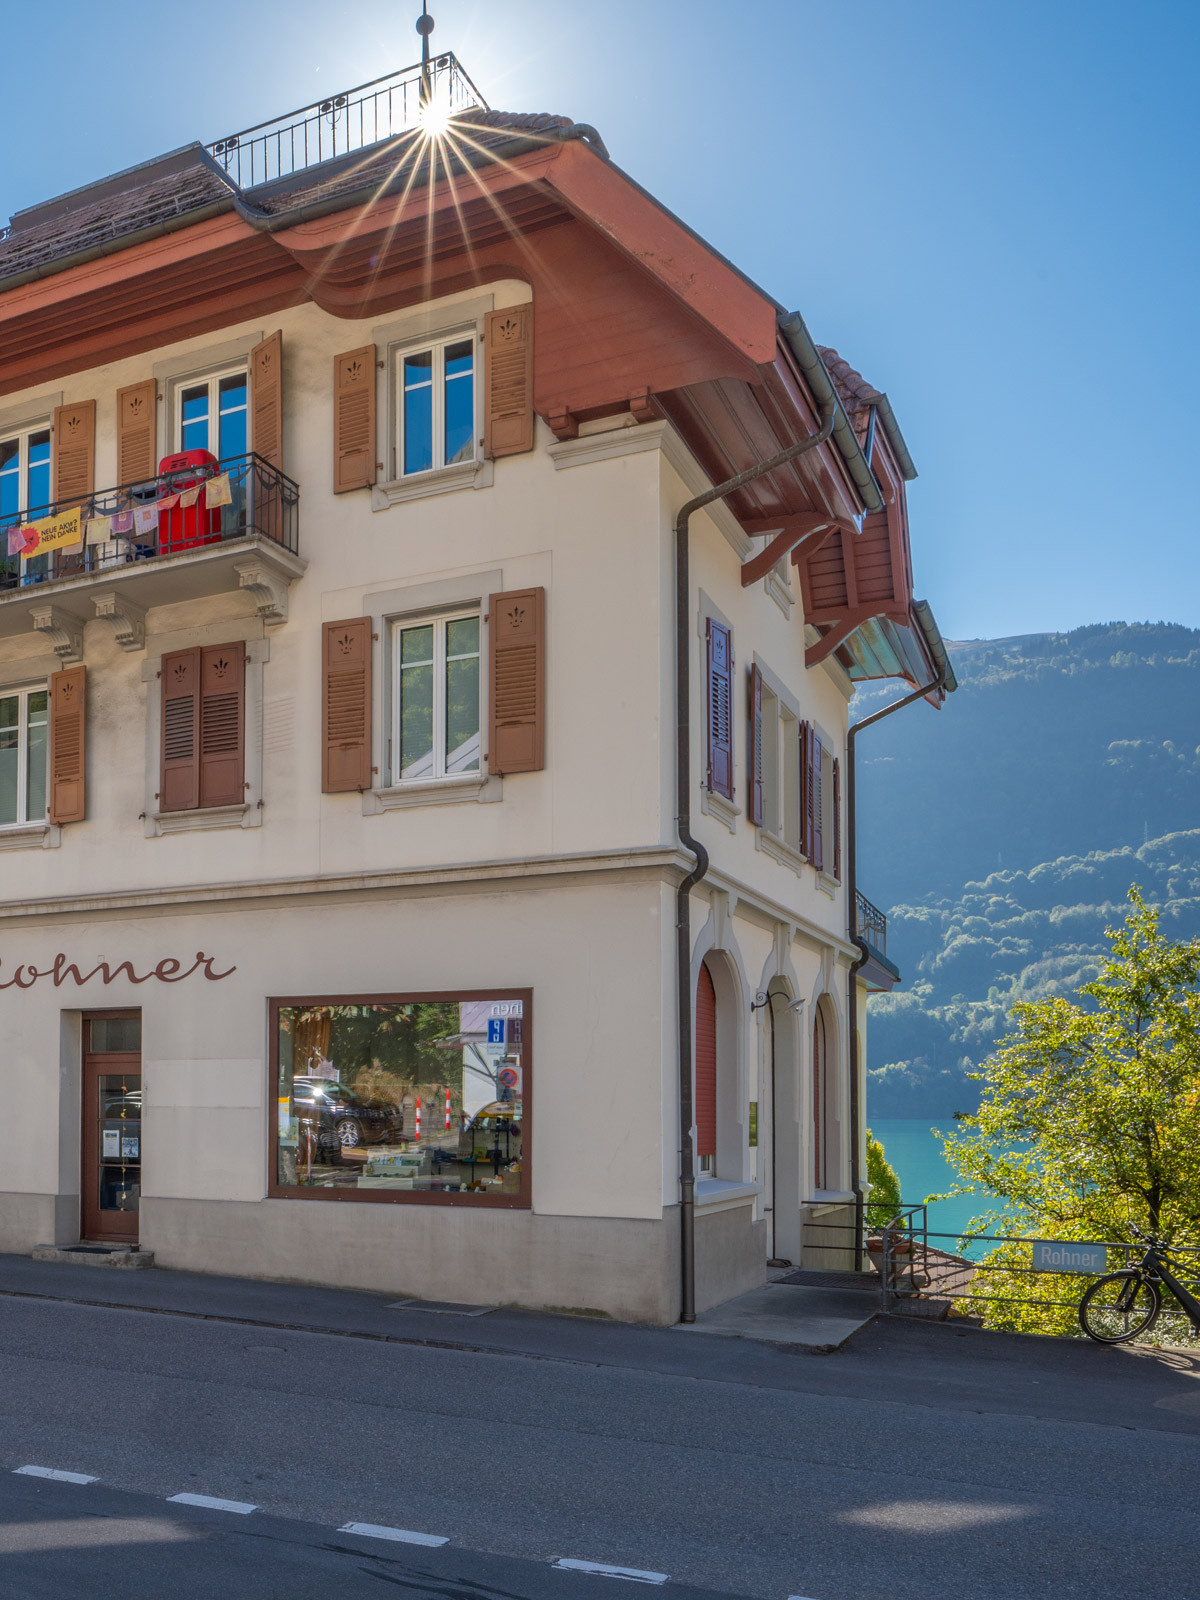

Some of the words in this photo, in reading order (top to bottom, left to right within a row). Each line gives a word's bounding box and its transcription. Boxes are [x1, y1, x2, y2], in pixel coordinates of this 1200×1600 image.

[41, 525, 57, 536] NEUE
[59, 518, 78, 530] AKW?
[41, 534, 56, 543] NEIN
[57, 526, 78, 538] DANKE
[1041, 1246, 1098, 1267] Rohner
